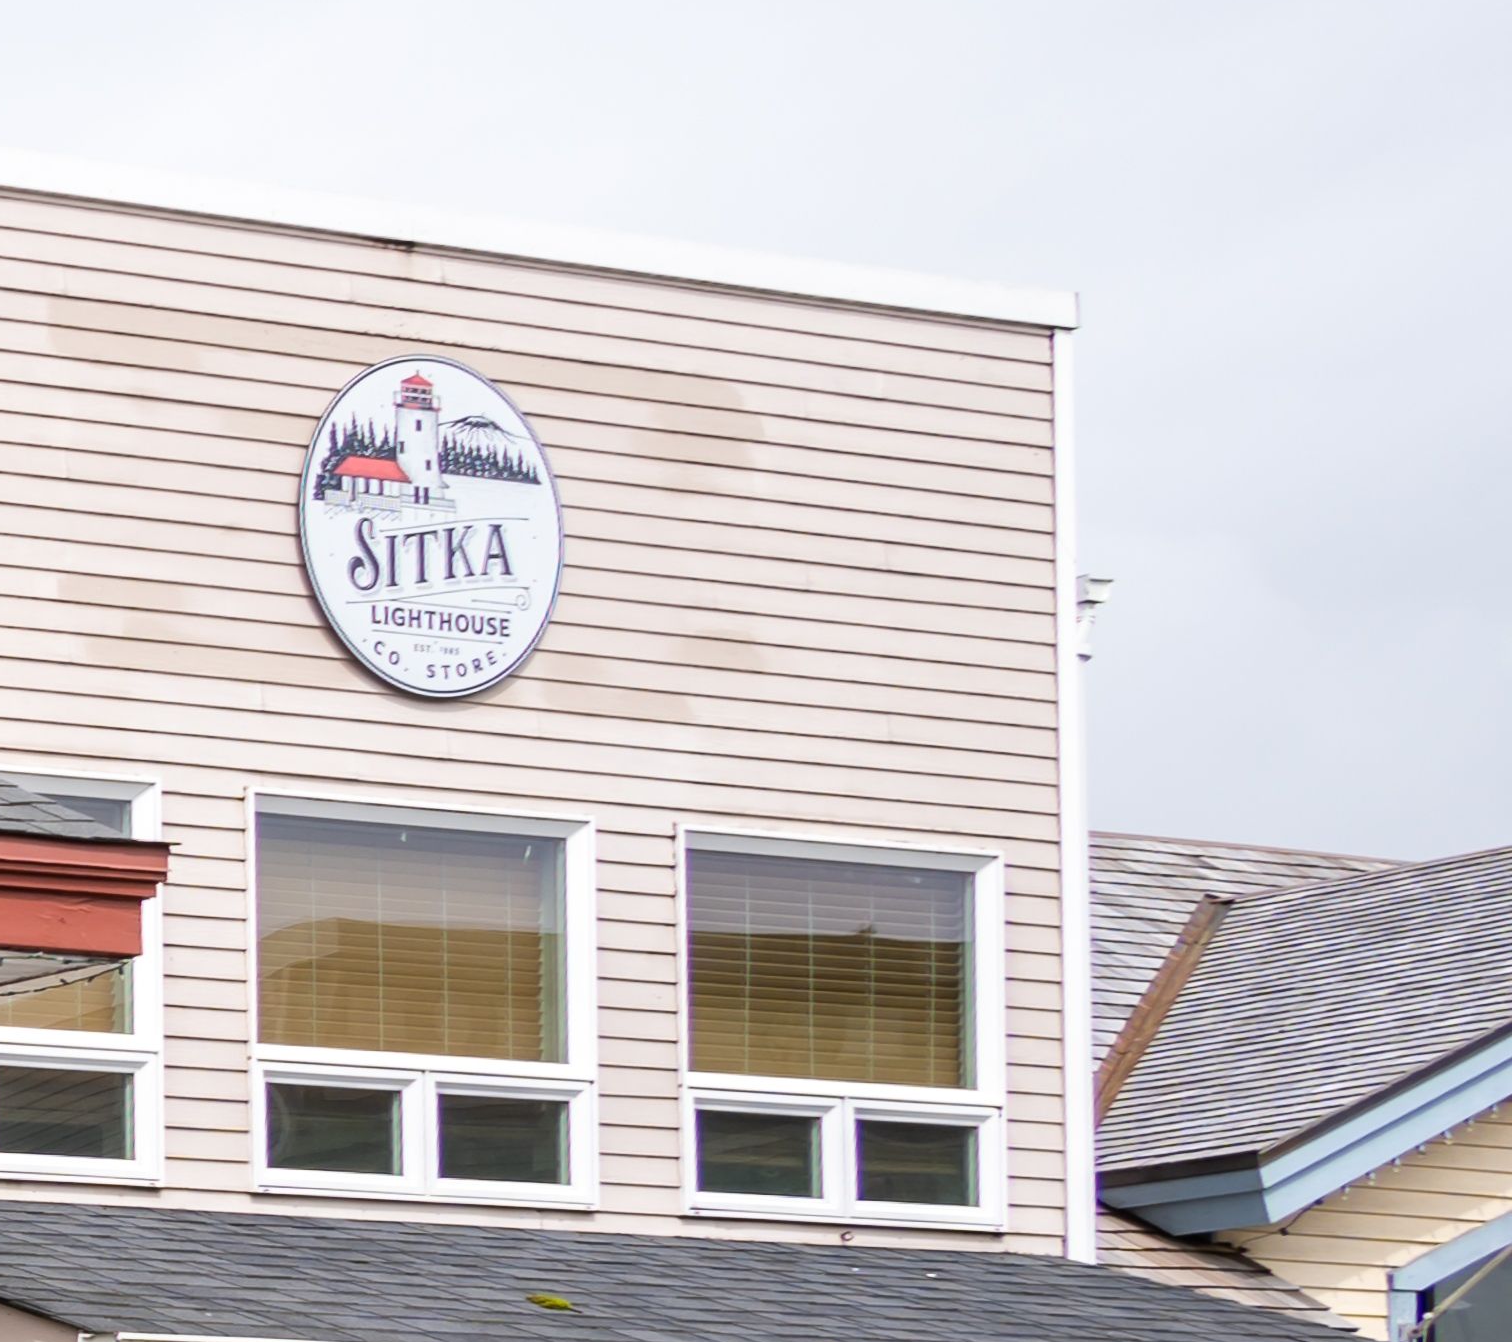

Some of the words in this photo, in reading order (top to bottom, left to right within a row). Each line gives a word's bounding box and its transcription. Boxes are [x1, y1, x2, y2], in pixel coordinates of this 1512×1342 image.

[348, 517, 513, 591] SITKA
[371, 605, 510, 637] LIGHTHOUSE
[427, 650, 497, 680] STORE
